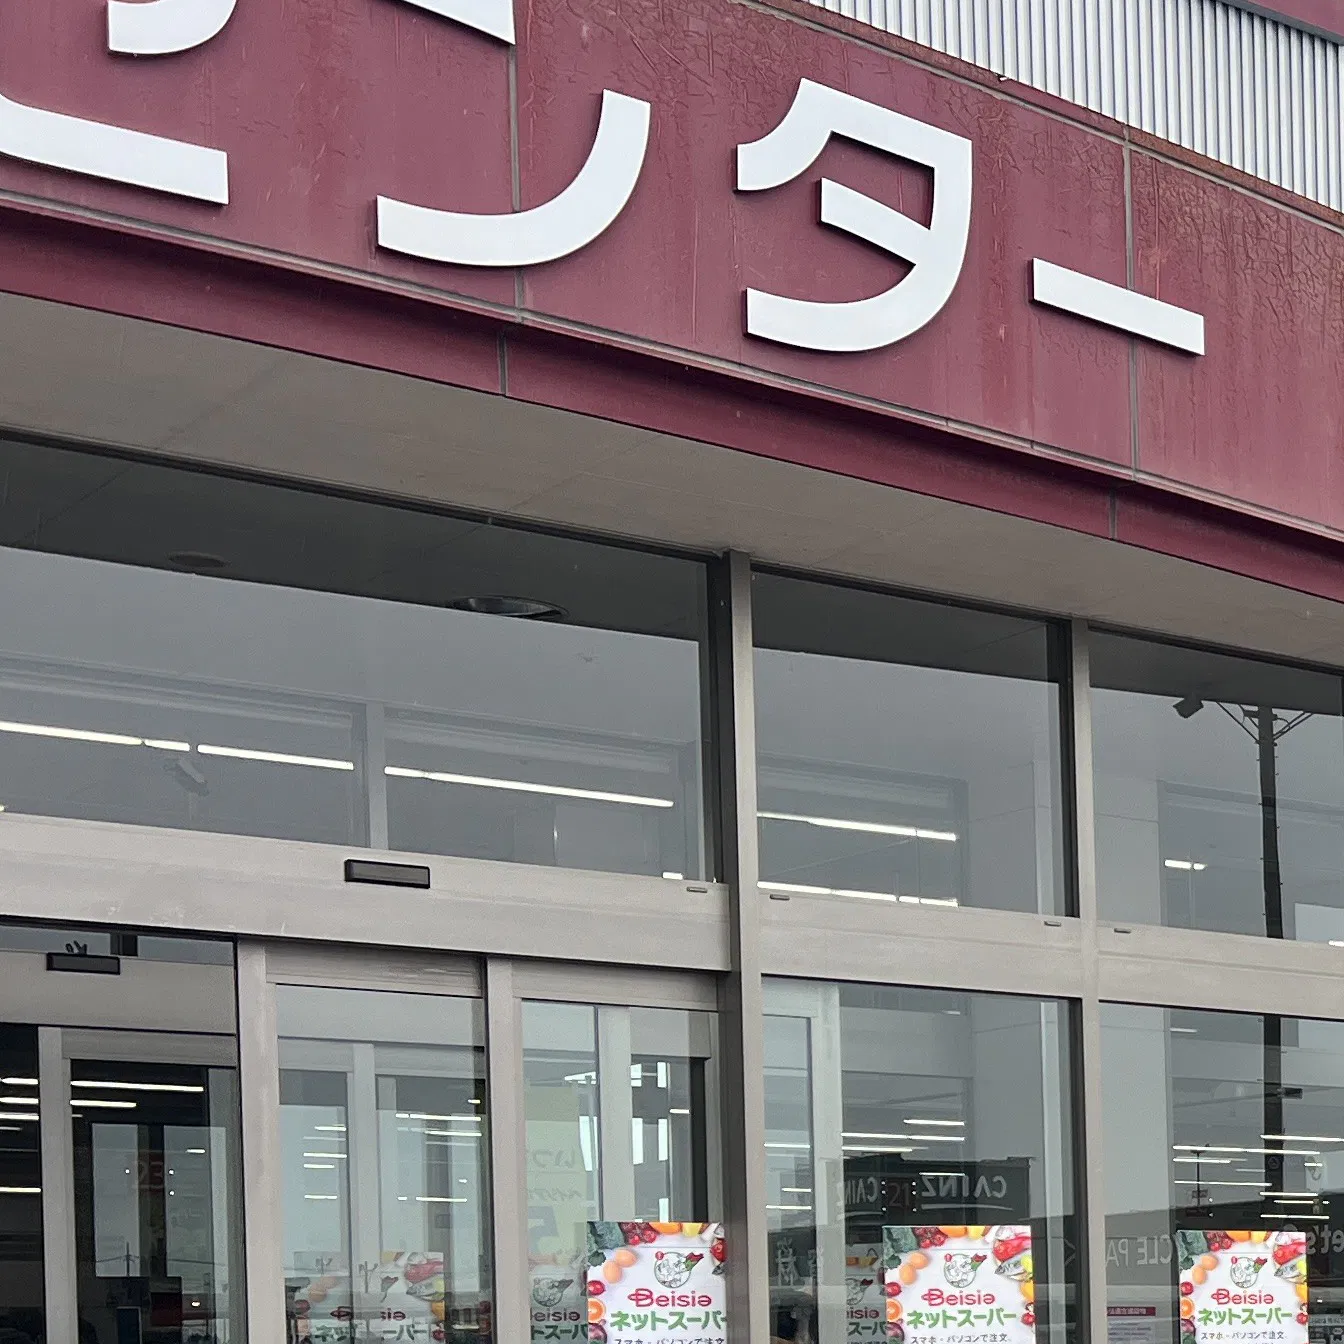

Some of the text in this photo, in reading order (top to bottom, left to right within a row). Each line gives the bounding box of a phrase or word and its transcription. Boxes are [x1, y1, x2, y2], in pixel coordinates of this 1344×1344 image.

[627, 1287, 713, 1308] Beisia
[920, 1288, 996, 1307] Beisia
[1210, 1288, 1275, 1305] Beisia
[906, 1308, 1017, 1330] ネットスーパー
[1198, 1307, 1293, 1326] ネットスーパー
